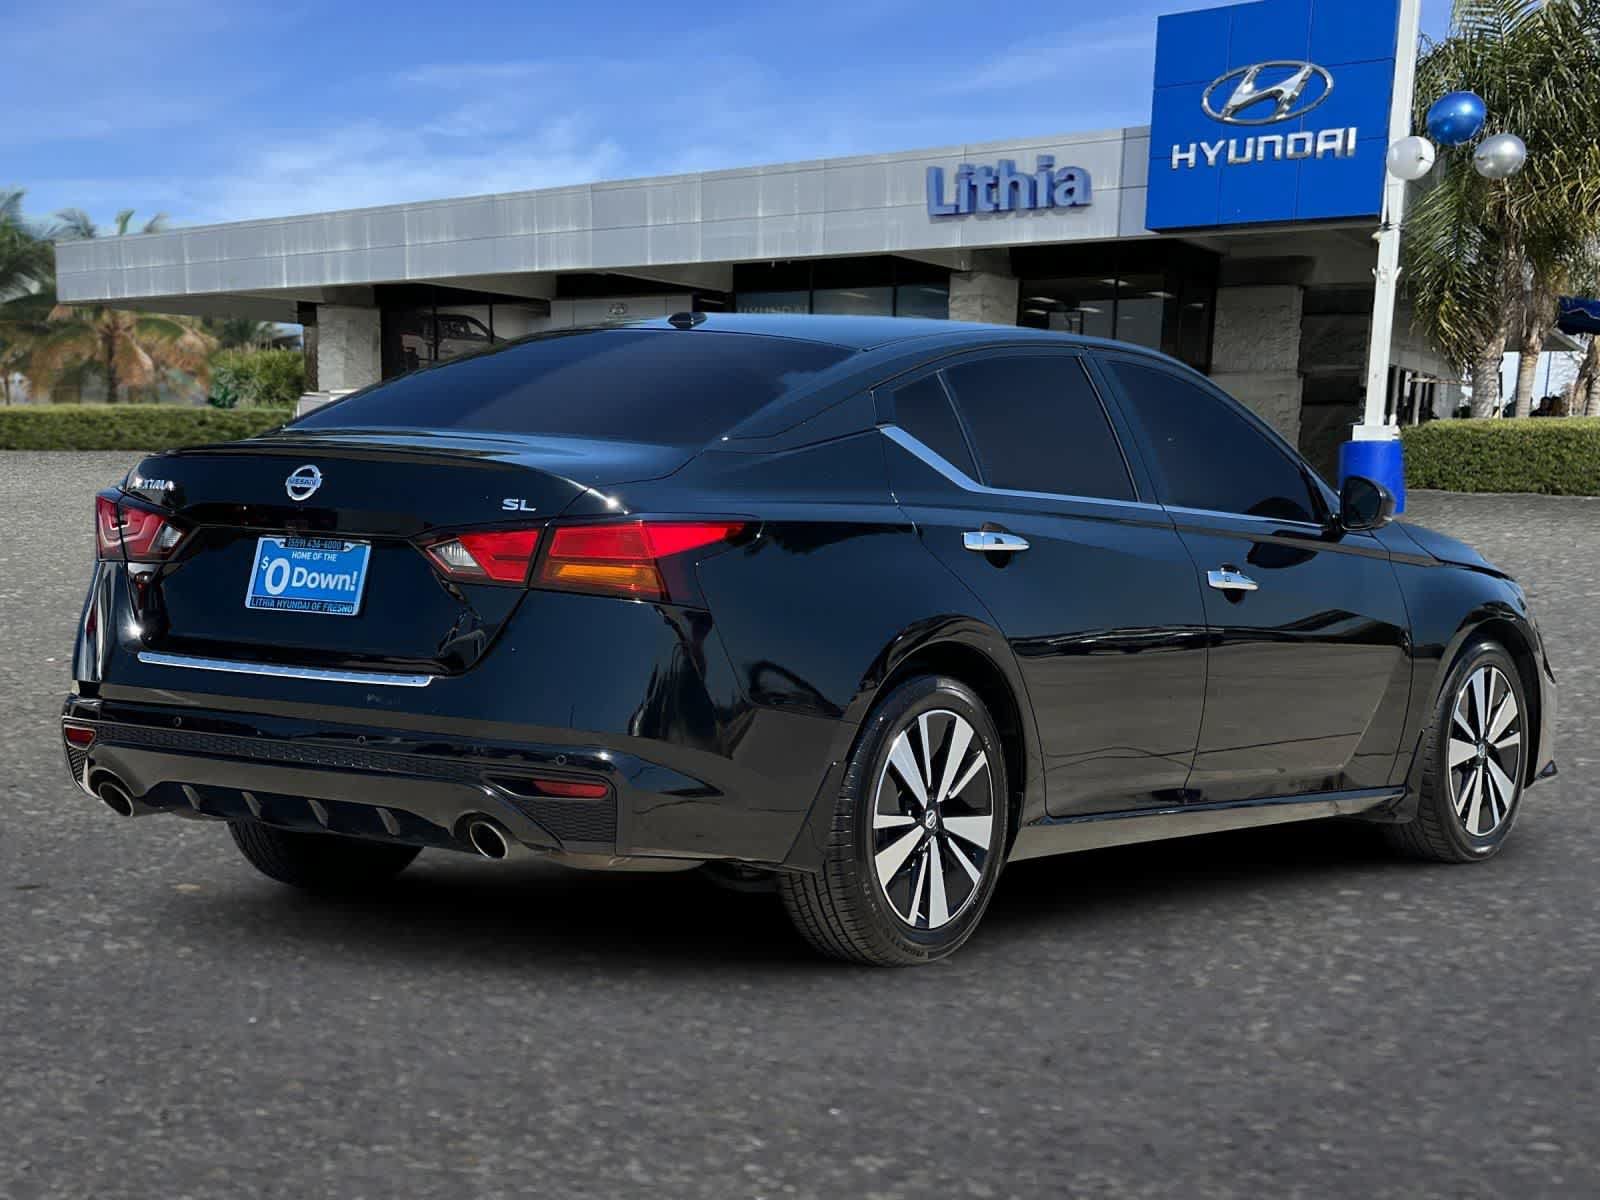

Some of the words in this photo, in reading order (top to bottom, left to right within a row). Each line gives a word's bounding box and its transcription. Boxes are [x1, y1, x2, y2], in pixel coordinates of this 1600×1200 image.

[1171, 127, 1357, 170] HYUNDAI
[927, 156, 1092, 217] Lithia
[502, 498, 537, 512] SL
[292, 551, 312, 561] HOME
[313, 552, 322, 561] OF
[323, 552, 337, 562] THE
[292, 567, 358, 591] Down!
[251, 597, 275, 608] LITHIA
[276, 599, 310, 610] HYUNDAI
[311, 601, 321, 611] OF
[322, 603, 353, 613] FRESNO
